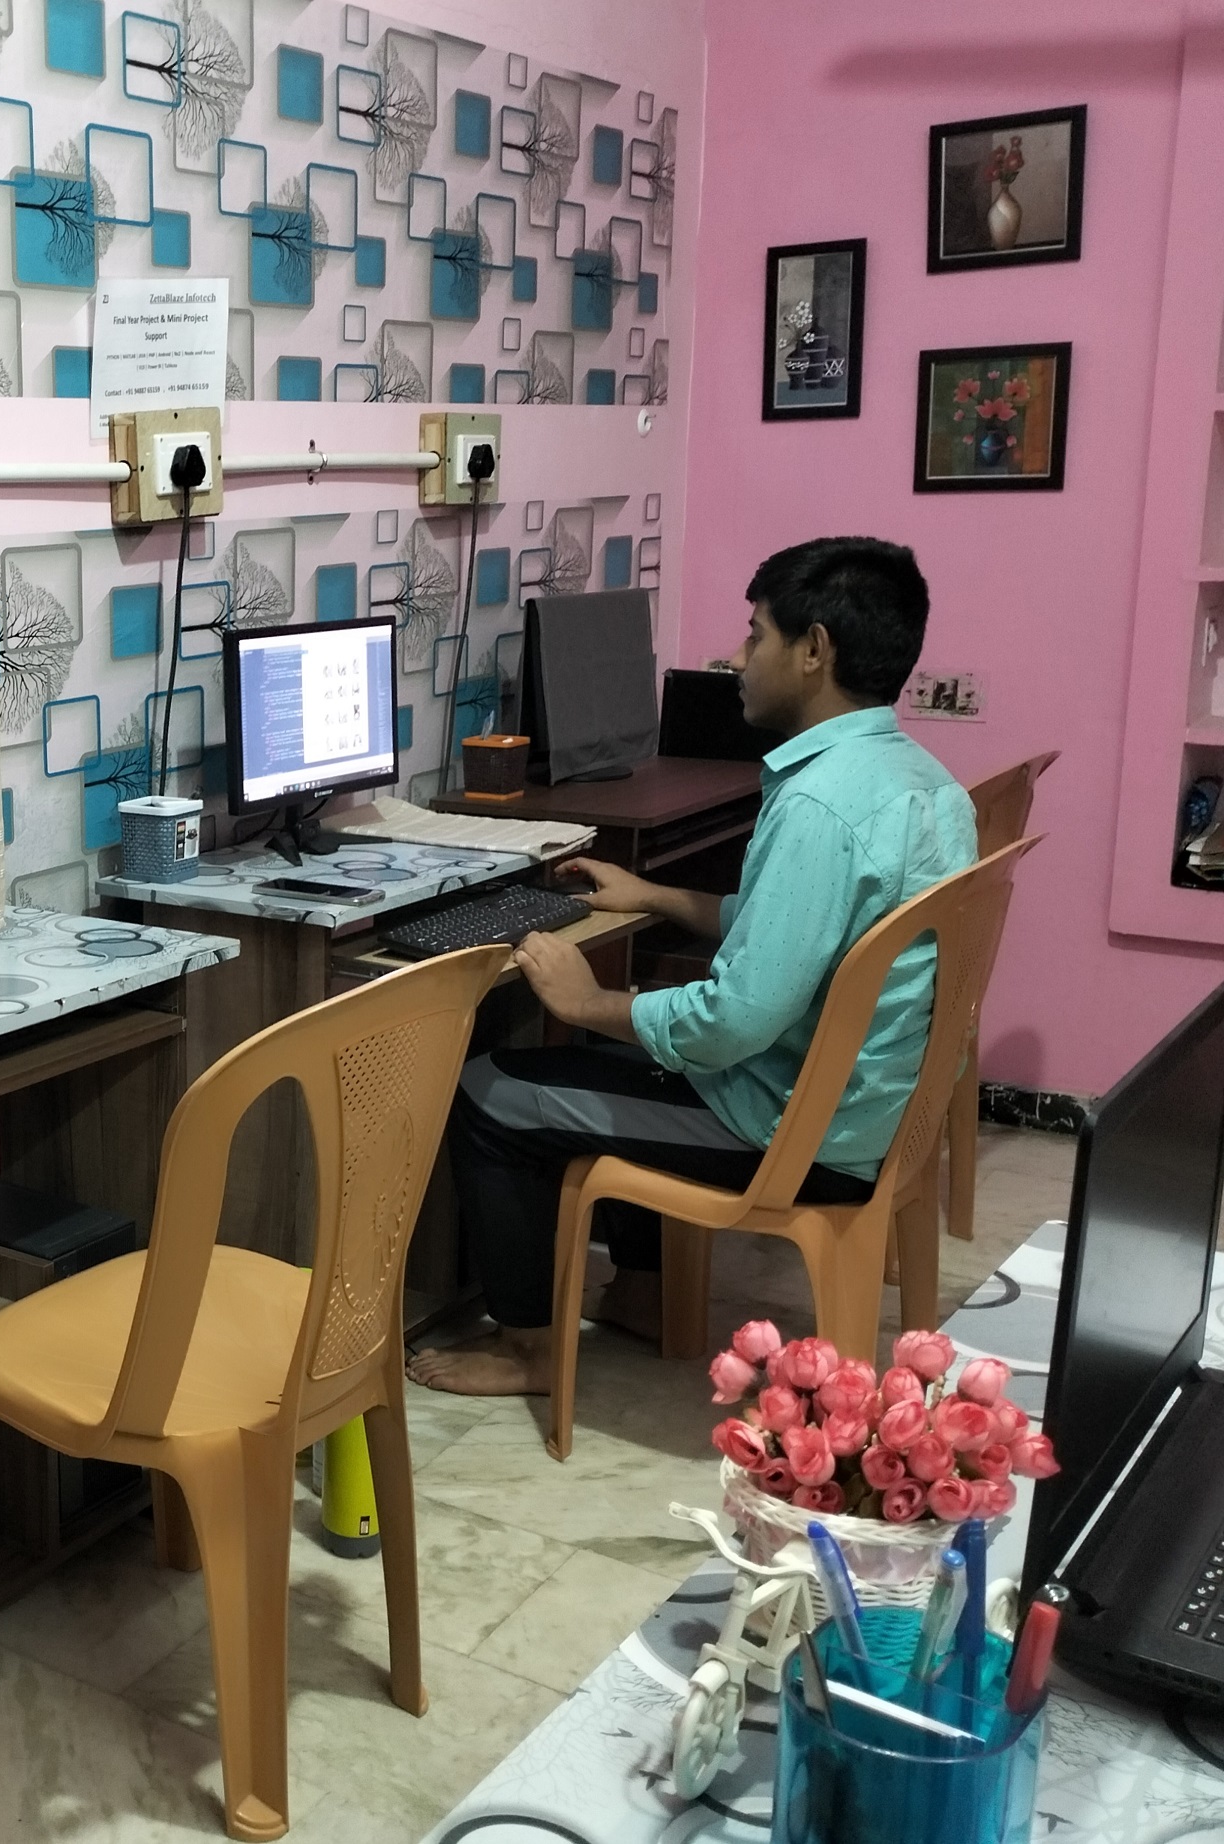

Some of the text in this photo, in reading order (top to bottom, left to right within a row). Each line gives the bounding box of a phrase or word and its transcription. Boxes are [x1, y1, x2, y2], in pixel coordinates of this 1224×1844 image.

[149, 293, 216, 304] ZettaBlaze Infotech
[113, 314, 209, 325] Final Year Project & Mini Project
[145, 332, 168, 342] Support
[105, 389, 122, 397] Contact
[167, 384, 176, 392] +91
[191, 382, 209, 391] 65159
